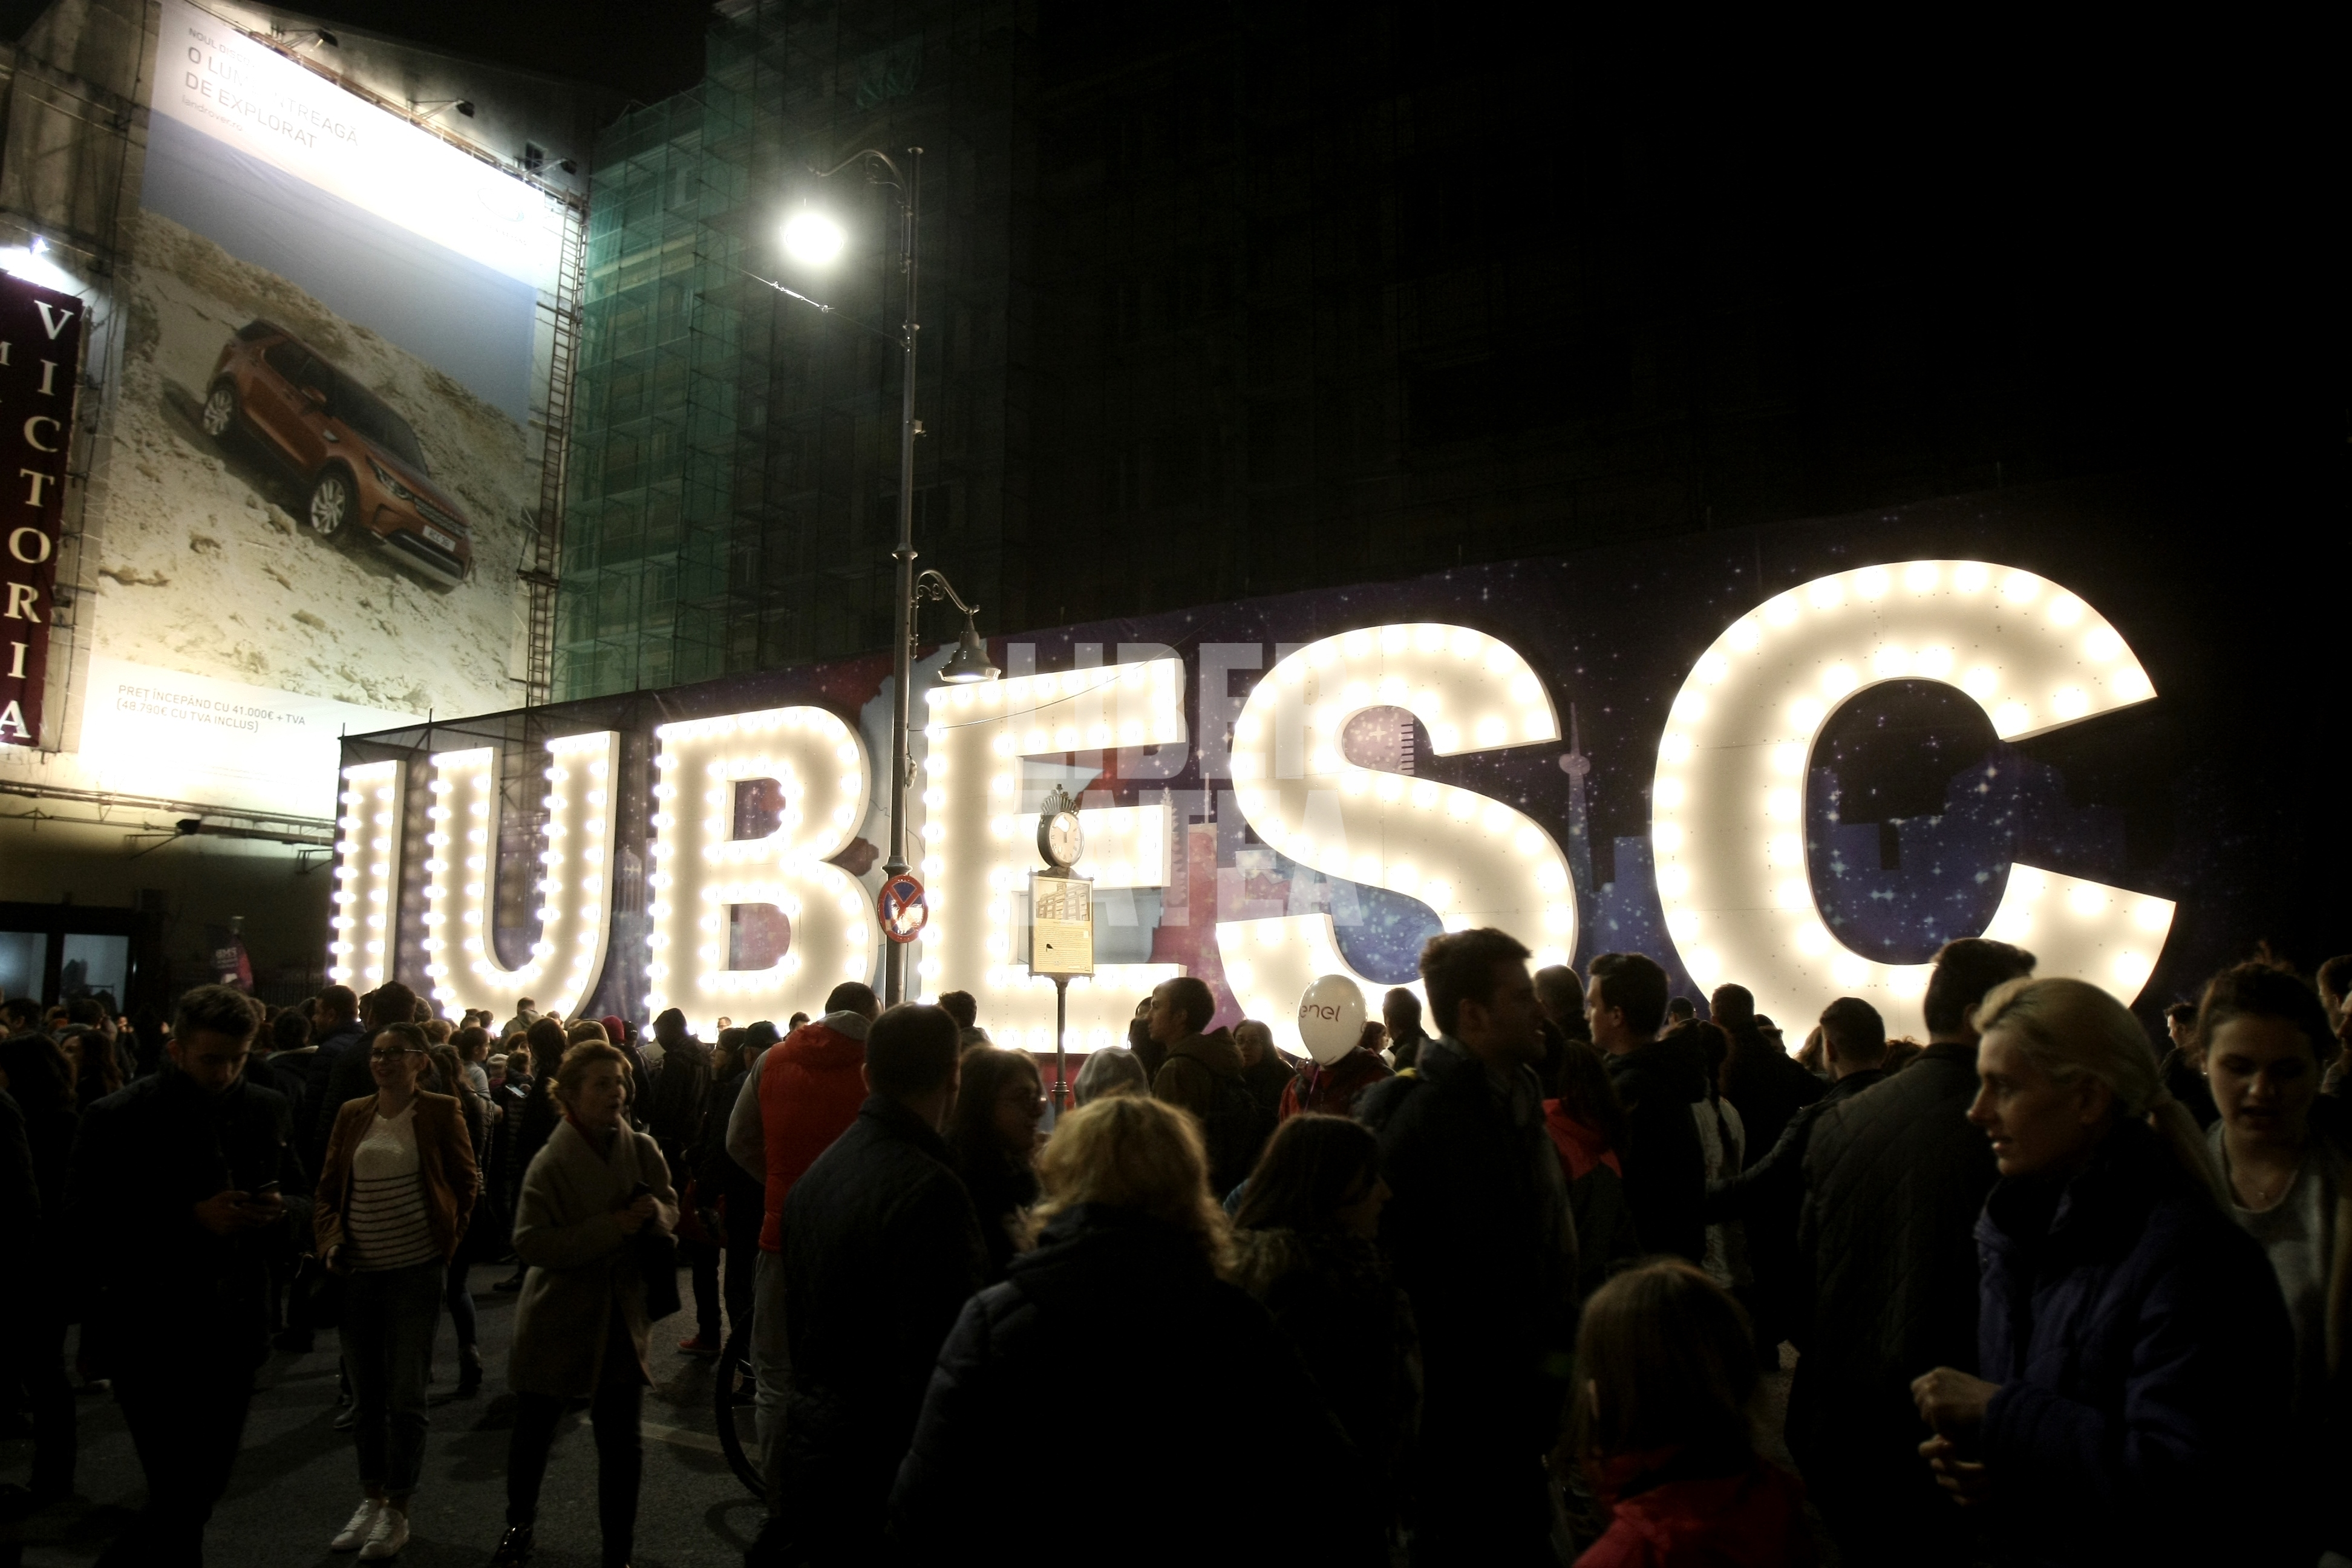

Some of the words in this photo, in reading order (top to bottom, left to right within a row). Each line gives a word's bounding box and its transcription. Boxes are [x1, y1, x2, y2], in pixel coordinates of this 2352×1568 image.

[189, 27, 217, 49] NOUL
[185, 71, 213, 98] DE
[218, 88, 318, 148] EXPLORAT
[188, 47, 201, 64] O
[209, 56, 259, 95] LUM
[273, 92, 358, 146] NTREAGĂ
[0, 300, 73, 739] VICTORIA
[152, 688, 211, 710] ÎNCEPÂND
[214, 702, 229, 713] CU
[232, 705, 274, 720] 41.000€
[286, 714, 305, 726] TVA
[171, 708, 186, 719] CU
[190, 711, 212, 724] TVA
[329, 560, 2177, 1060] IUBESC
[1301, 1005, 1341, 1021] enel
